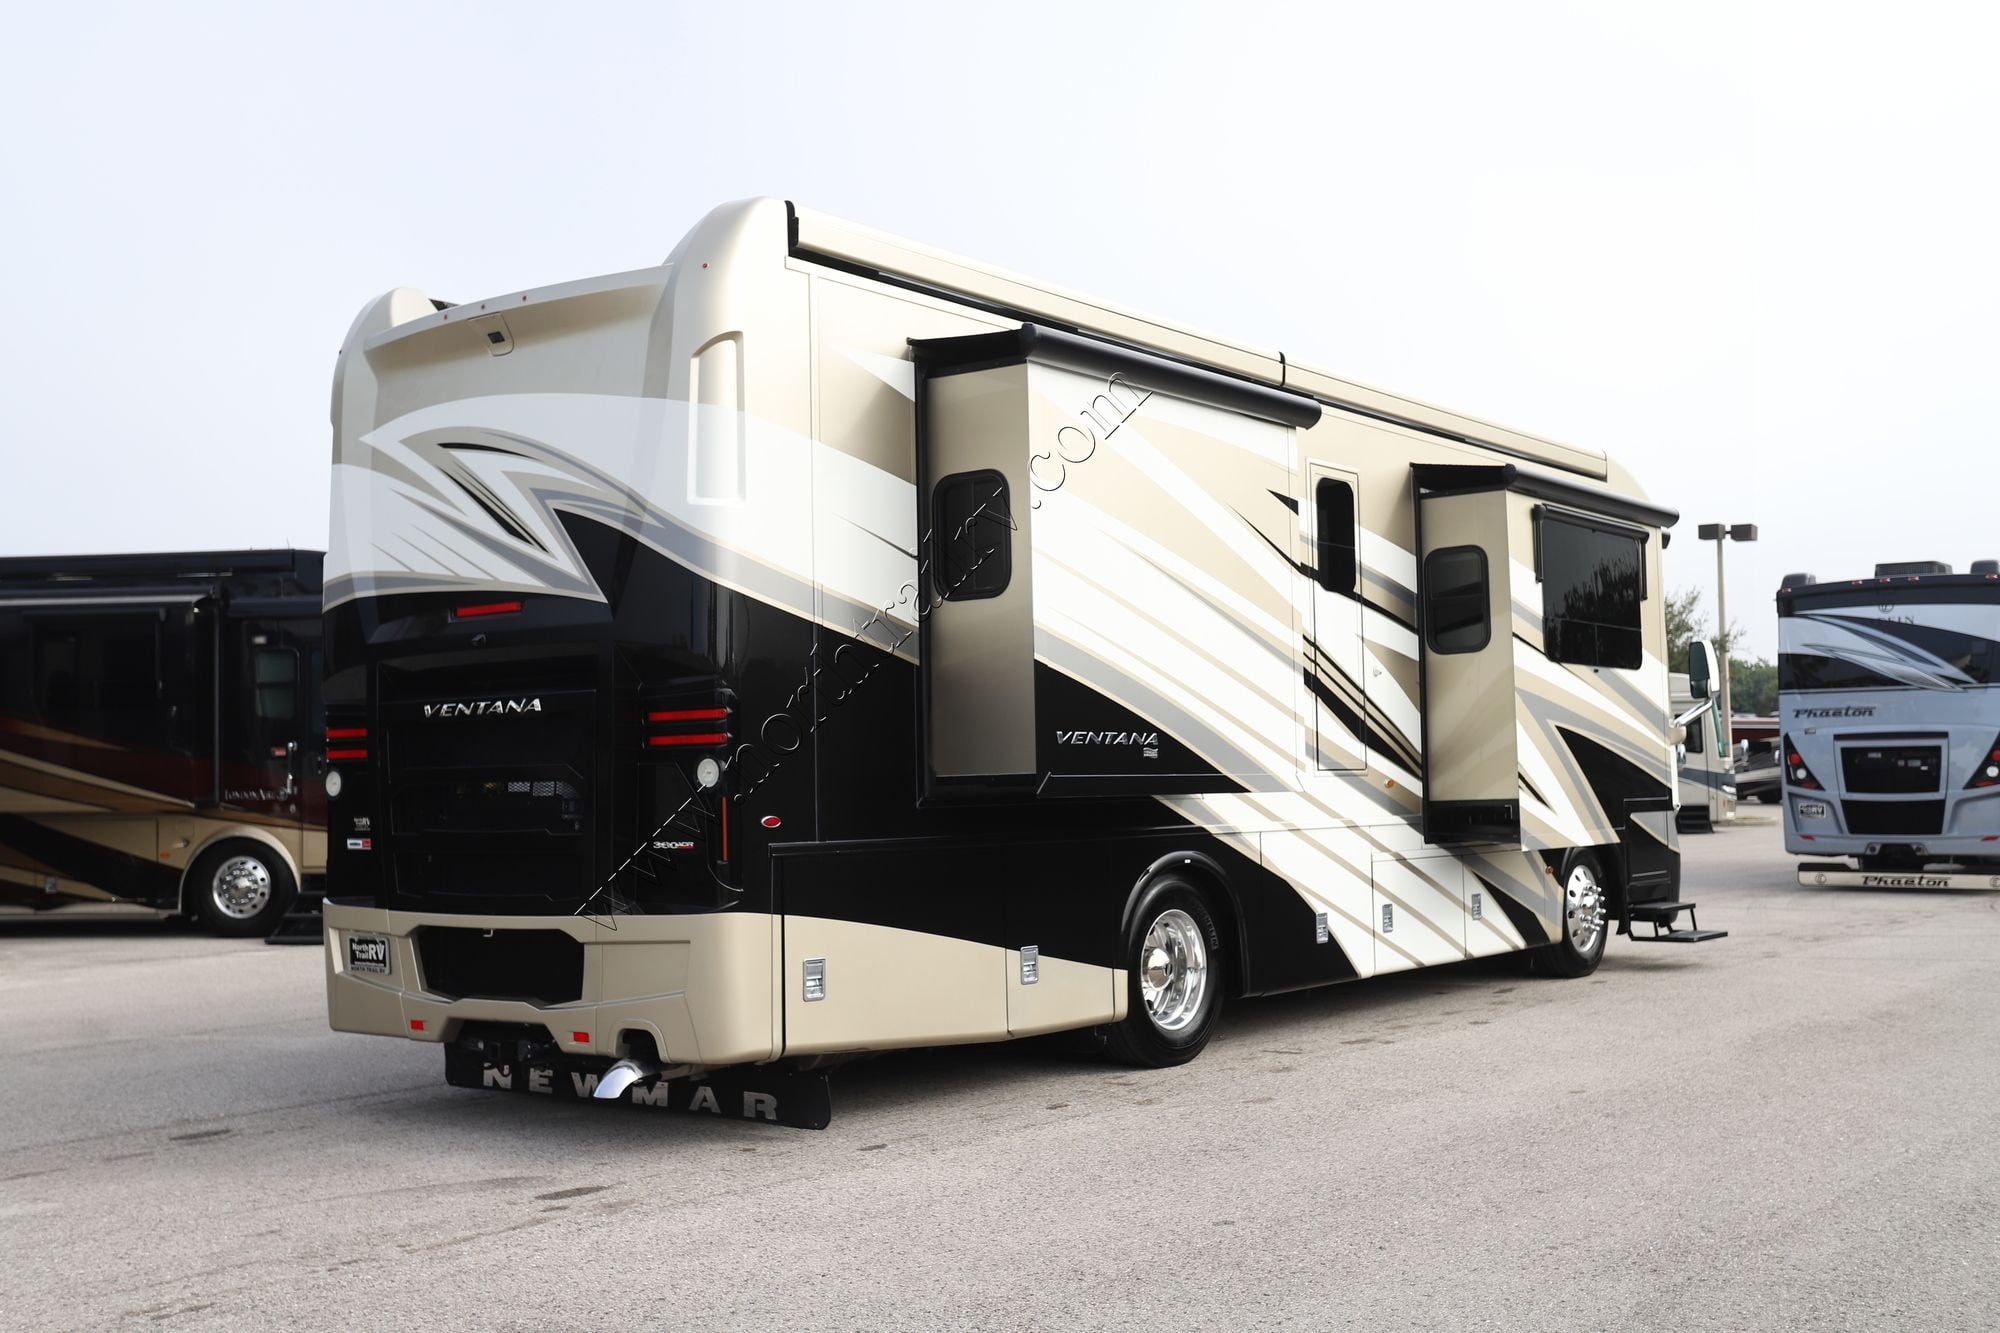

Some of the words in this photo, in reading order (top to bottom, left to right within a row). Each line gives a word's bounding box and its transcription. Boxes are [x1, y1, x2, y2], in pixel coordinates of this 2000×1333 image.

[424, 698, 541, 718] VENTANA
[1793, 706, 1877, 718] Phaeton
[1056, 731, 1158, 745] VENTANA
[1862, 874, 1951, 887] Phaeton
[352, 943, 369, 951] North
[368, 943, 385, 960] RV
[356, 950, 369, 959] Trail
[483, 1062, 777, 1121] NEWMAR
